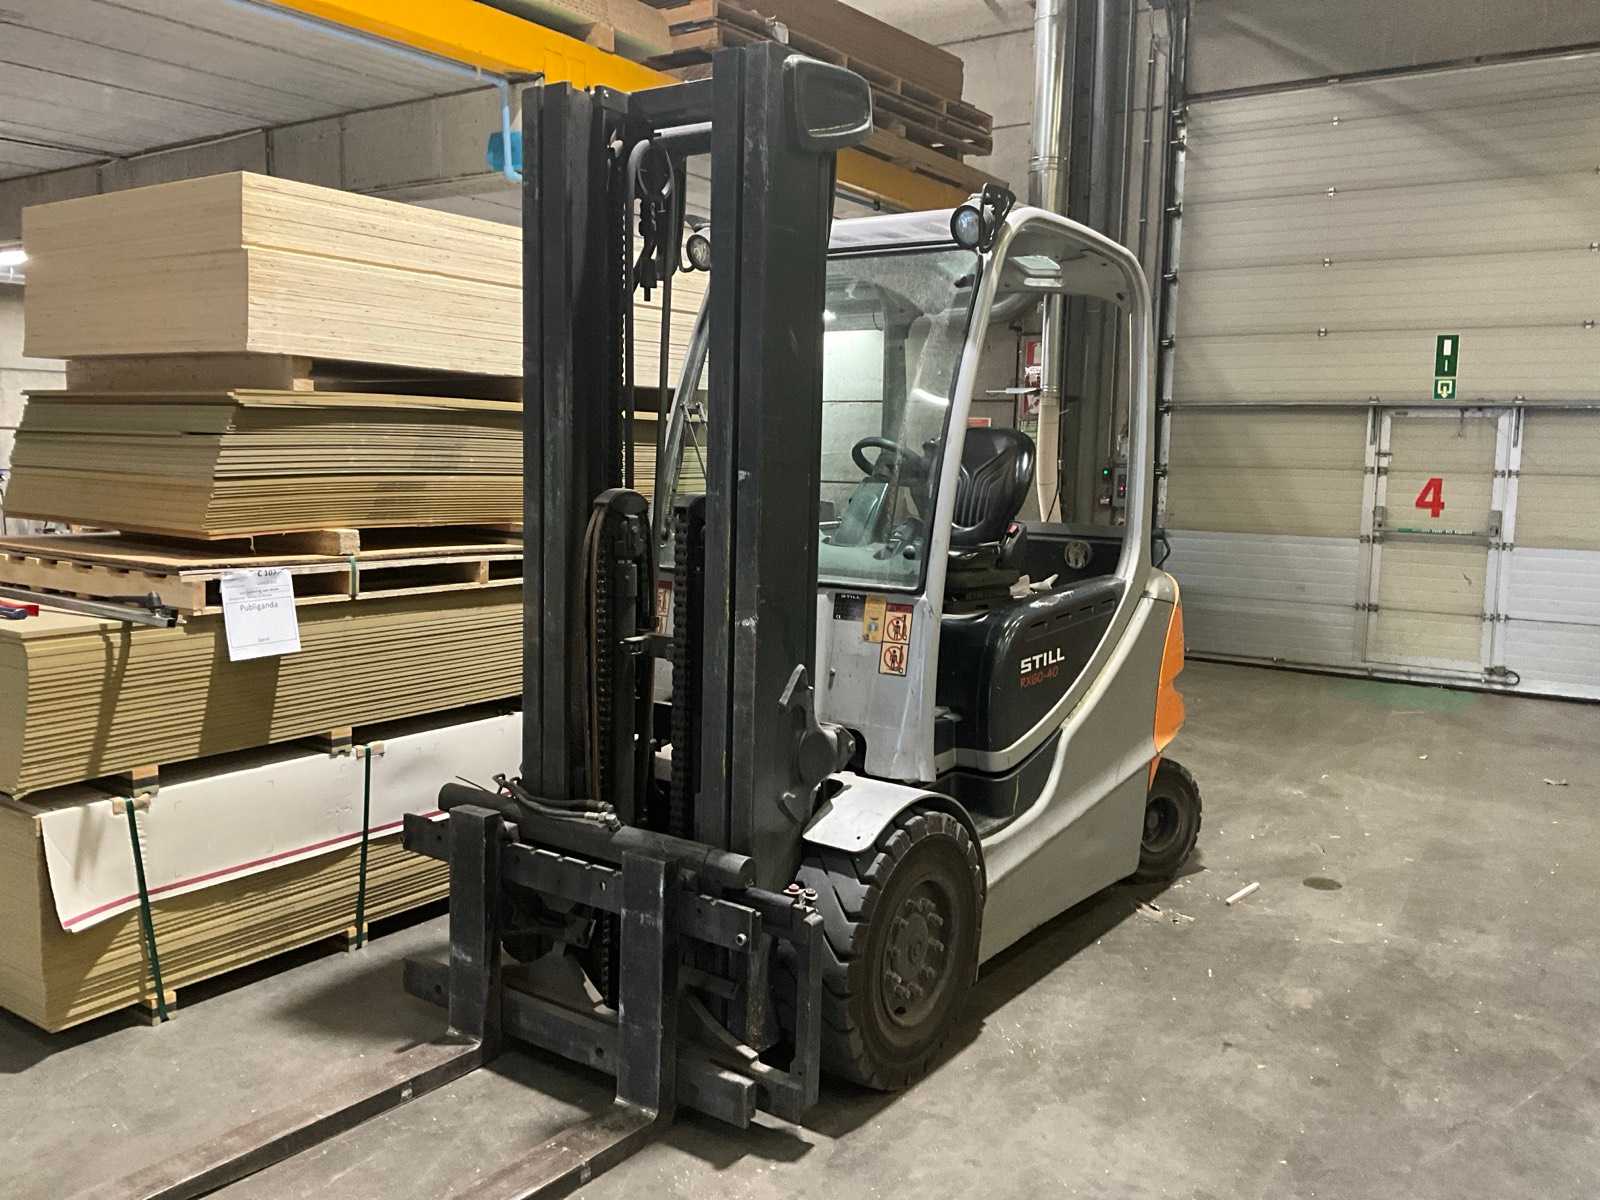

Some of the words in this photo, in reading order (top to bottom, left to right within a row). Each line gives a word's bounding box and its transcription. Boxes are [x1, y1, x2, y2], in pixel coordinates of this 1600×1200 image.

[1414, 477, 1445, 519] 4
[240, 602, 279, 612] Publiganda
[1020, 647, 1065, 674] STILL
[1019, 665, 1059, 688] RX60-40
